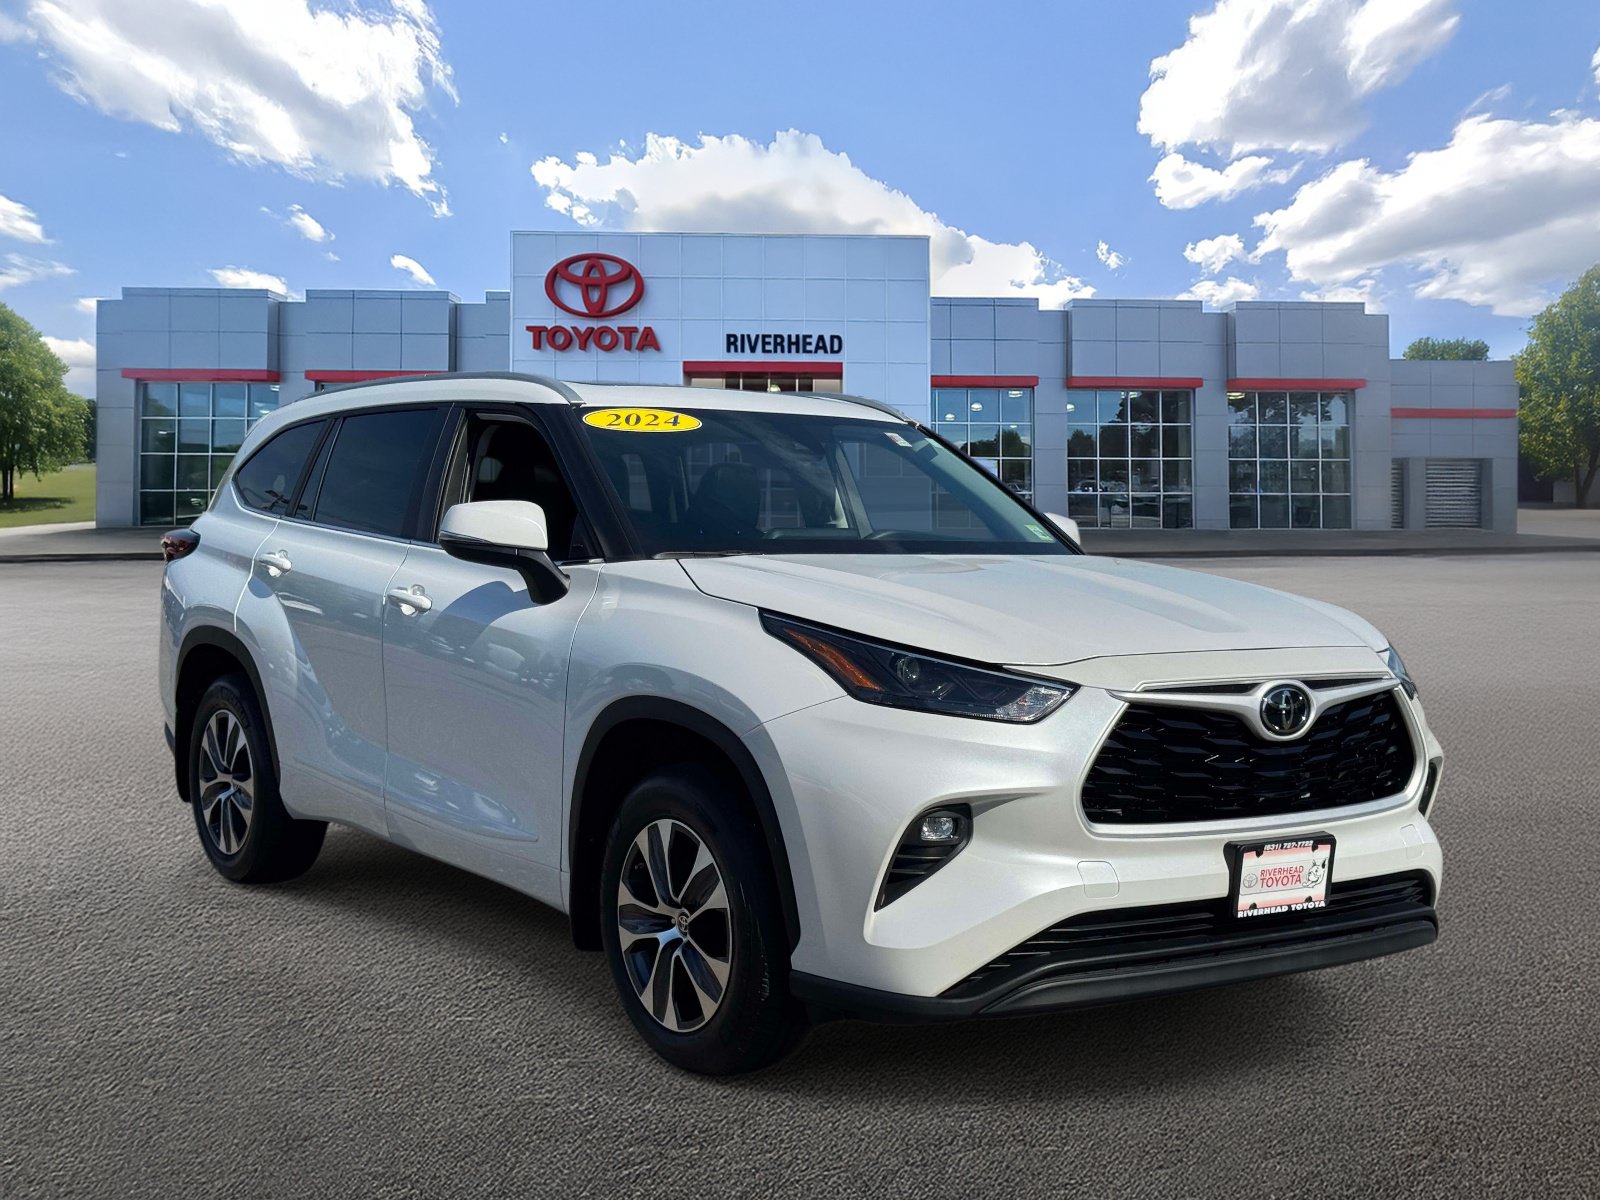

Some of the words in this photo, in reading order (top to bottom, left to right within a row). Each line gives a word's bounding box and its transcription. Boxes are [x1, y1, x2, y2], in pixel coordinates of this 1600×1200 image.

[526, 326, 661, 352] TOYOTA
[725, 333, 844, 355] RIVERHEAD
[606, 412, 681, 427] 2024
[1260, 866, 1304, 877] RIVERHEAD
[1260, 874, 1302, 888] TOYOTA
[1238, 906, 1288, 918] RIVERHEAD
[1291, 901, 1325, 911] TOYOTA
